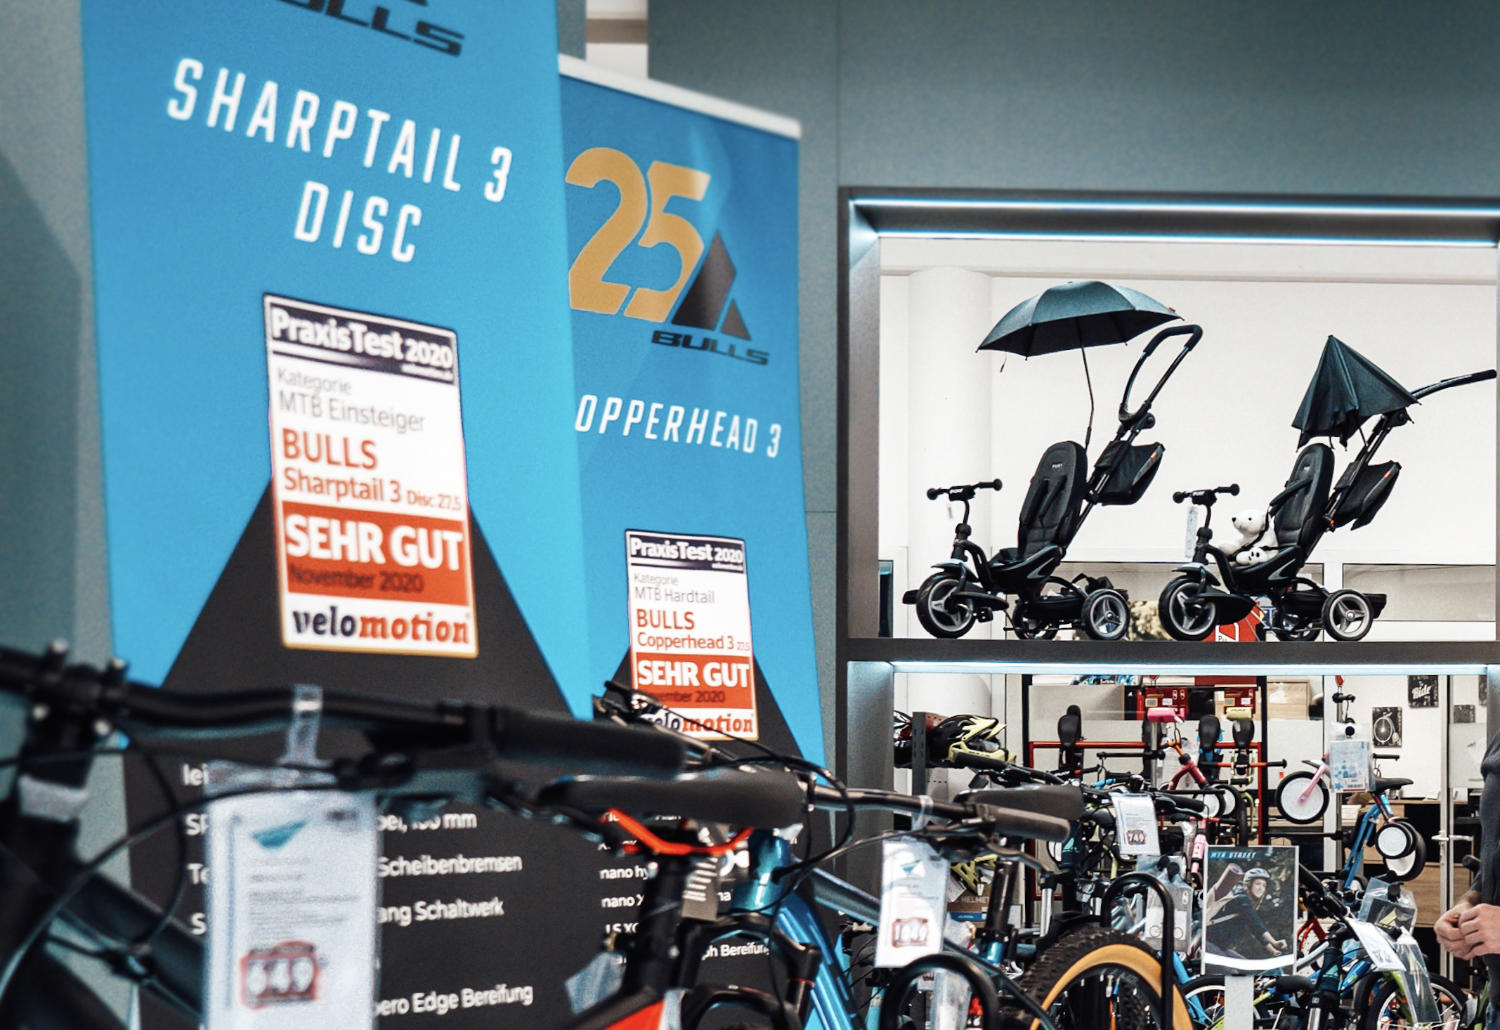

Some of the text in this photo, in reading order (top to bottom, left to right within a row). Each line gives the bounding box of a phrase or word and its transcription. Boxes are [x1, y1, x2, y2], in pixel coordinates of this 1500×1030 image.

[167, 57, 512, 202] SHARPTAIL 3
[294, 180, 422, 262] DISC
[565, 147, 711, 323] 25
[271, 307, 453, 368] PraxisTest 2020
[651, 330, 770, 366] BULLS
[277, 368, 352, 394] Kategorie
[278, 390, 426, 434] MTB Einsteiger
[575, 394, 782, 458] OPPERHEAD 3
[281, 427, 378, 470] BULLS
[283, 467, 385, 502] Sharptail
[389, 480, 401, 503] 3
[285, 513, 464, 571] SEHR GUT
[630, 537, 743, 563] PraxisTest 2020
[288, 563, 425, 594] November 2020
[633, 571, 679, 586] Kategorie
[634, 586, 715, 604] MTB Hardtail
[291, 605, 469, 644] velomotion
[636, 608, 695, 630] BULLS
[637, 631, 724, 651] Copperhead
[727, 636, 735, 650] 3
[637, 659, 750, 687] SEHR GUT
[695, 690, 726, 703] 2020
[377, 854, 523, 877] Scheibenbremsen
[414, 896, 505, 921] Schaltwerk
[412, 990, 459, 1016] Edge
[460, 983, 534, 1009] Bereifung
